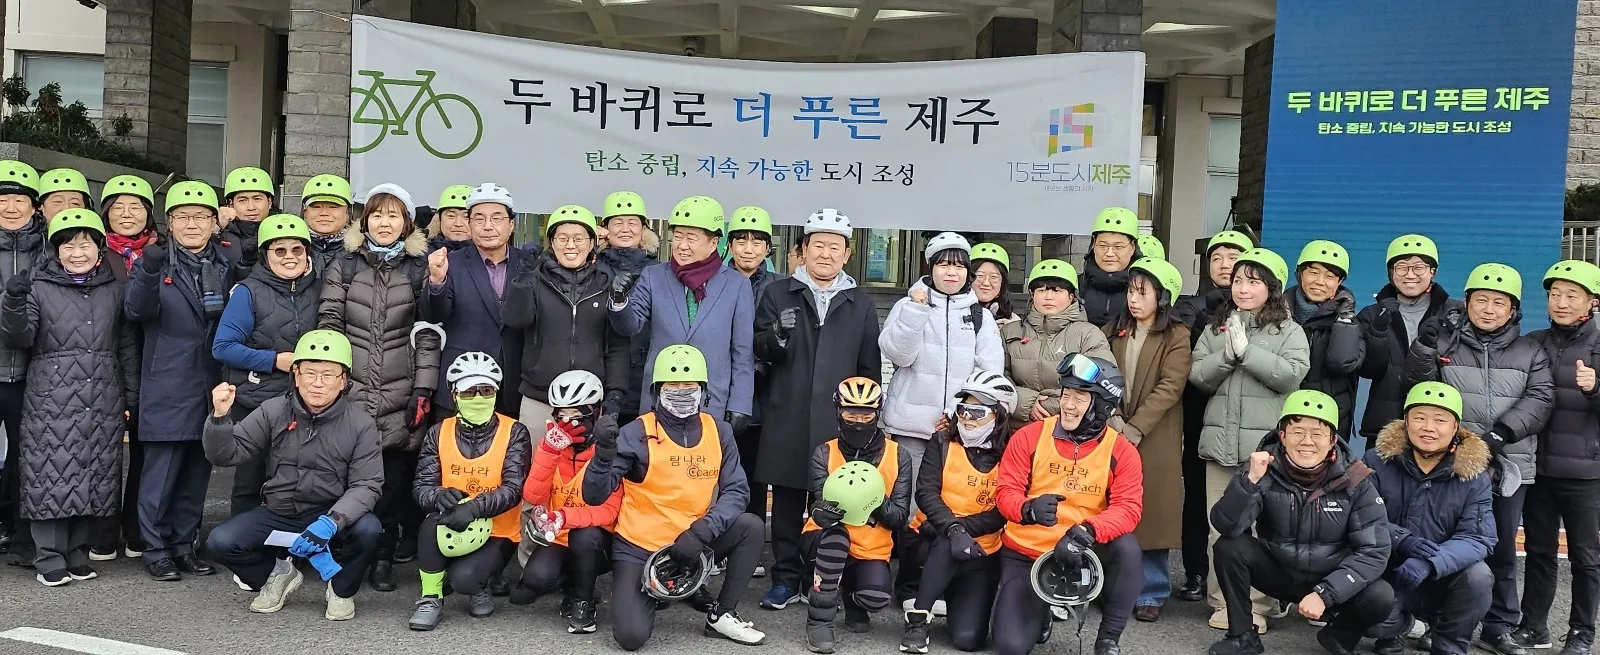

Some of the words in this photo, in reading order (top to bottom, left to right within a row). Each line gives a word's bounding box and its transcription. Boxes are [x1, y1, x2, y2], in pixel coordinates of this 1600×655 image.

[1288, 91, 1312, 114] 두
[1319, 90, 1394, 113] 바퀴로
[1402, 89, 1428, 112] 더
[1434, 88, 1488, 112] 푸른
[1494, 86, 1550, 112] 제주
[503, 79, 552, 125] 두
[570, 81, 713, 133] 바퀴로
[733, 92, 772, 138] 더
[793, 96, 888, 141] 푸른
[905, 96, 1000, 145] 제주
[1318, 122, 1343, 135] 탄소
[1346, 121, 1376, 135] 중립,
[1378, 121, 1406, 134] 지속
[1408, 121, 1450, 134] 가능한
[1452, 121, 1480, 134] 도시
[1483, 120, 1512, 134] 조성
[585, 150, 630, 173] 탄소
[636, 152, 688, 178] 중립,
[696, 155, 740, 180] 지속
[747, 157, 814, 183] 가능한
[820, 160, 863, 185] 도시
[871, 163, 915, 186] 조성
[1006, 161, 1132, 185] 15분도시제주
[669, 454, 707, 467] 탐나라
[450, 463, 491, 477] 탐나라
[686, 465, 719, 480] Coach
[1049, 462, 1090, 479] 탐나라
[466, 481, 501, 494] Coac
[1064, 477, 1102, 494] Coach
